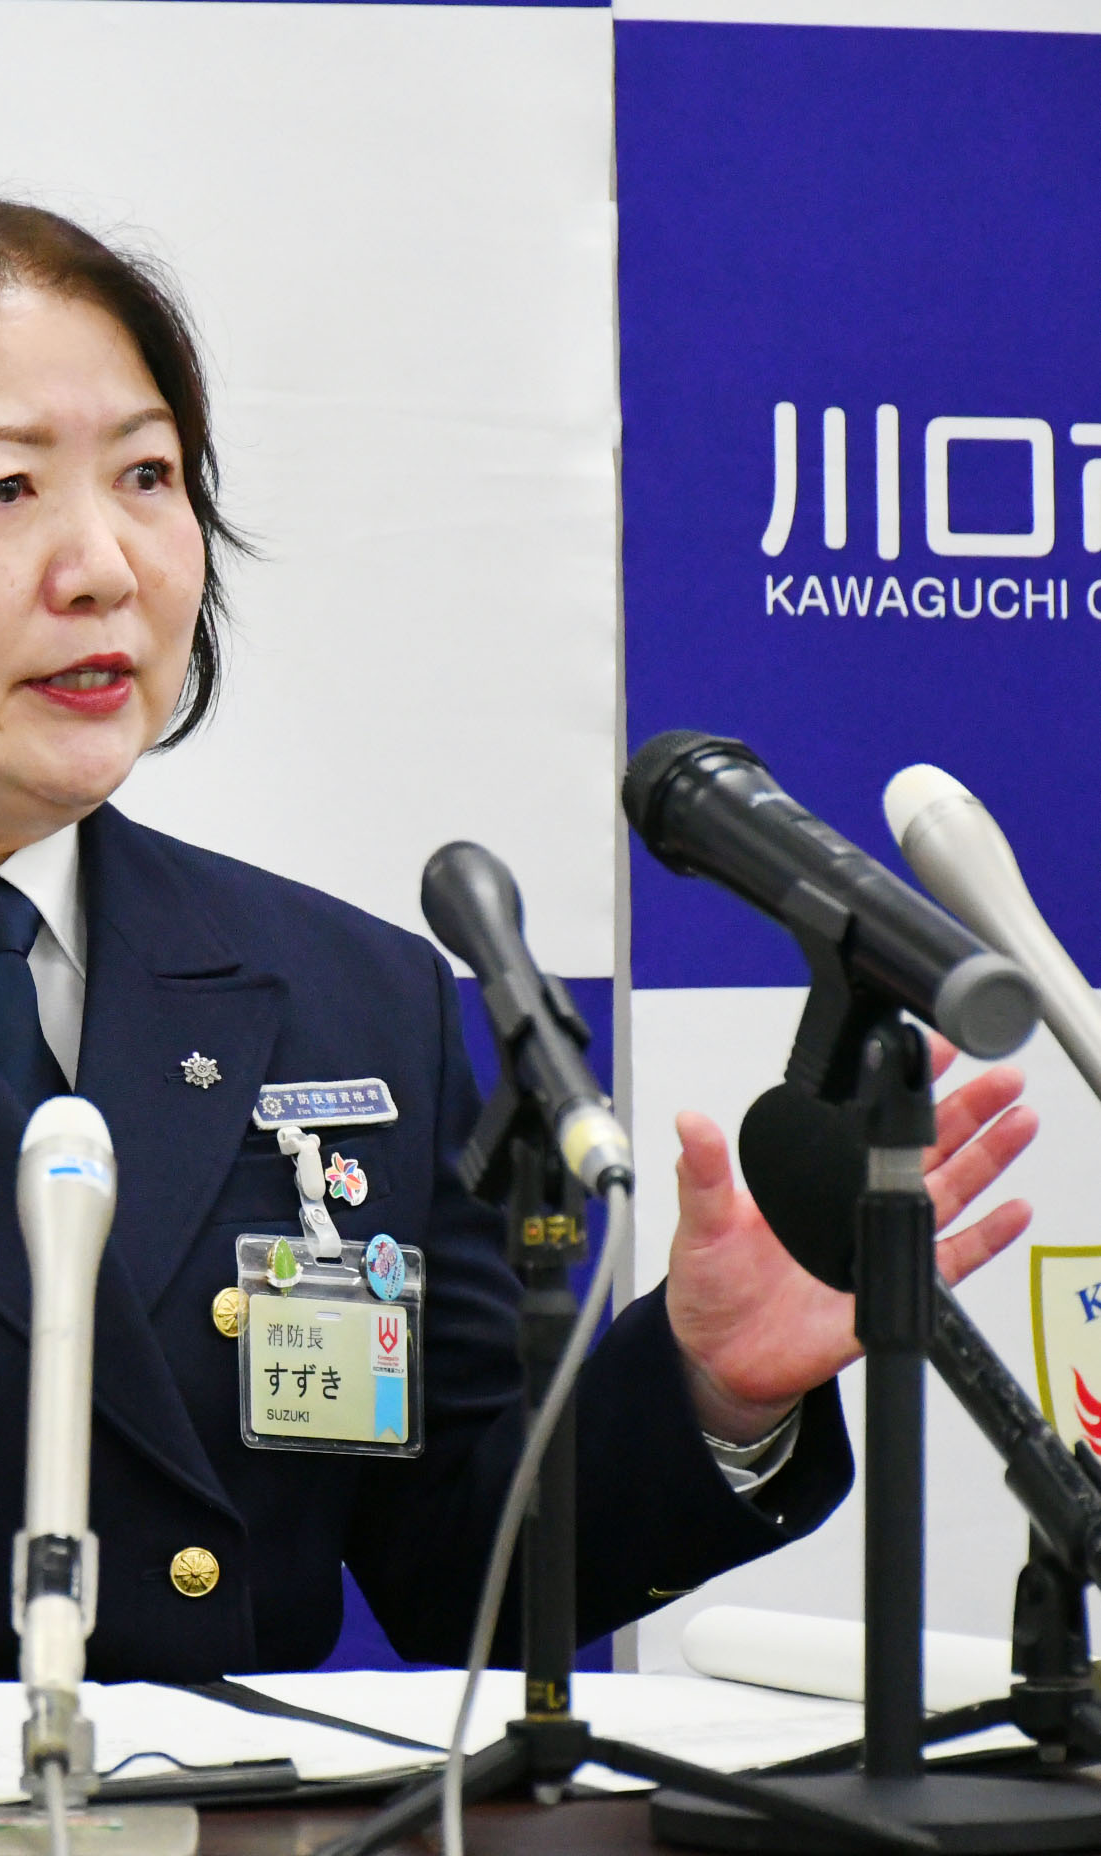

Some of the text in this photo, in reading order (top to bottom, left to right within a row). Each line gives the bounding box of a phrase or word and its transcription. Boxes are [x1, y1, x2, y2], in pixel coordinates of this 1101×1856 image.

[765, 574, 1068, 620] KAWAGUCHI
[266, 1323, 323, 1350] 消防長
[264, 1362, 342, 1400] すずき
[266, 1408, 310, 1423] SUZUKI
